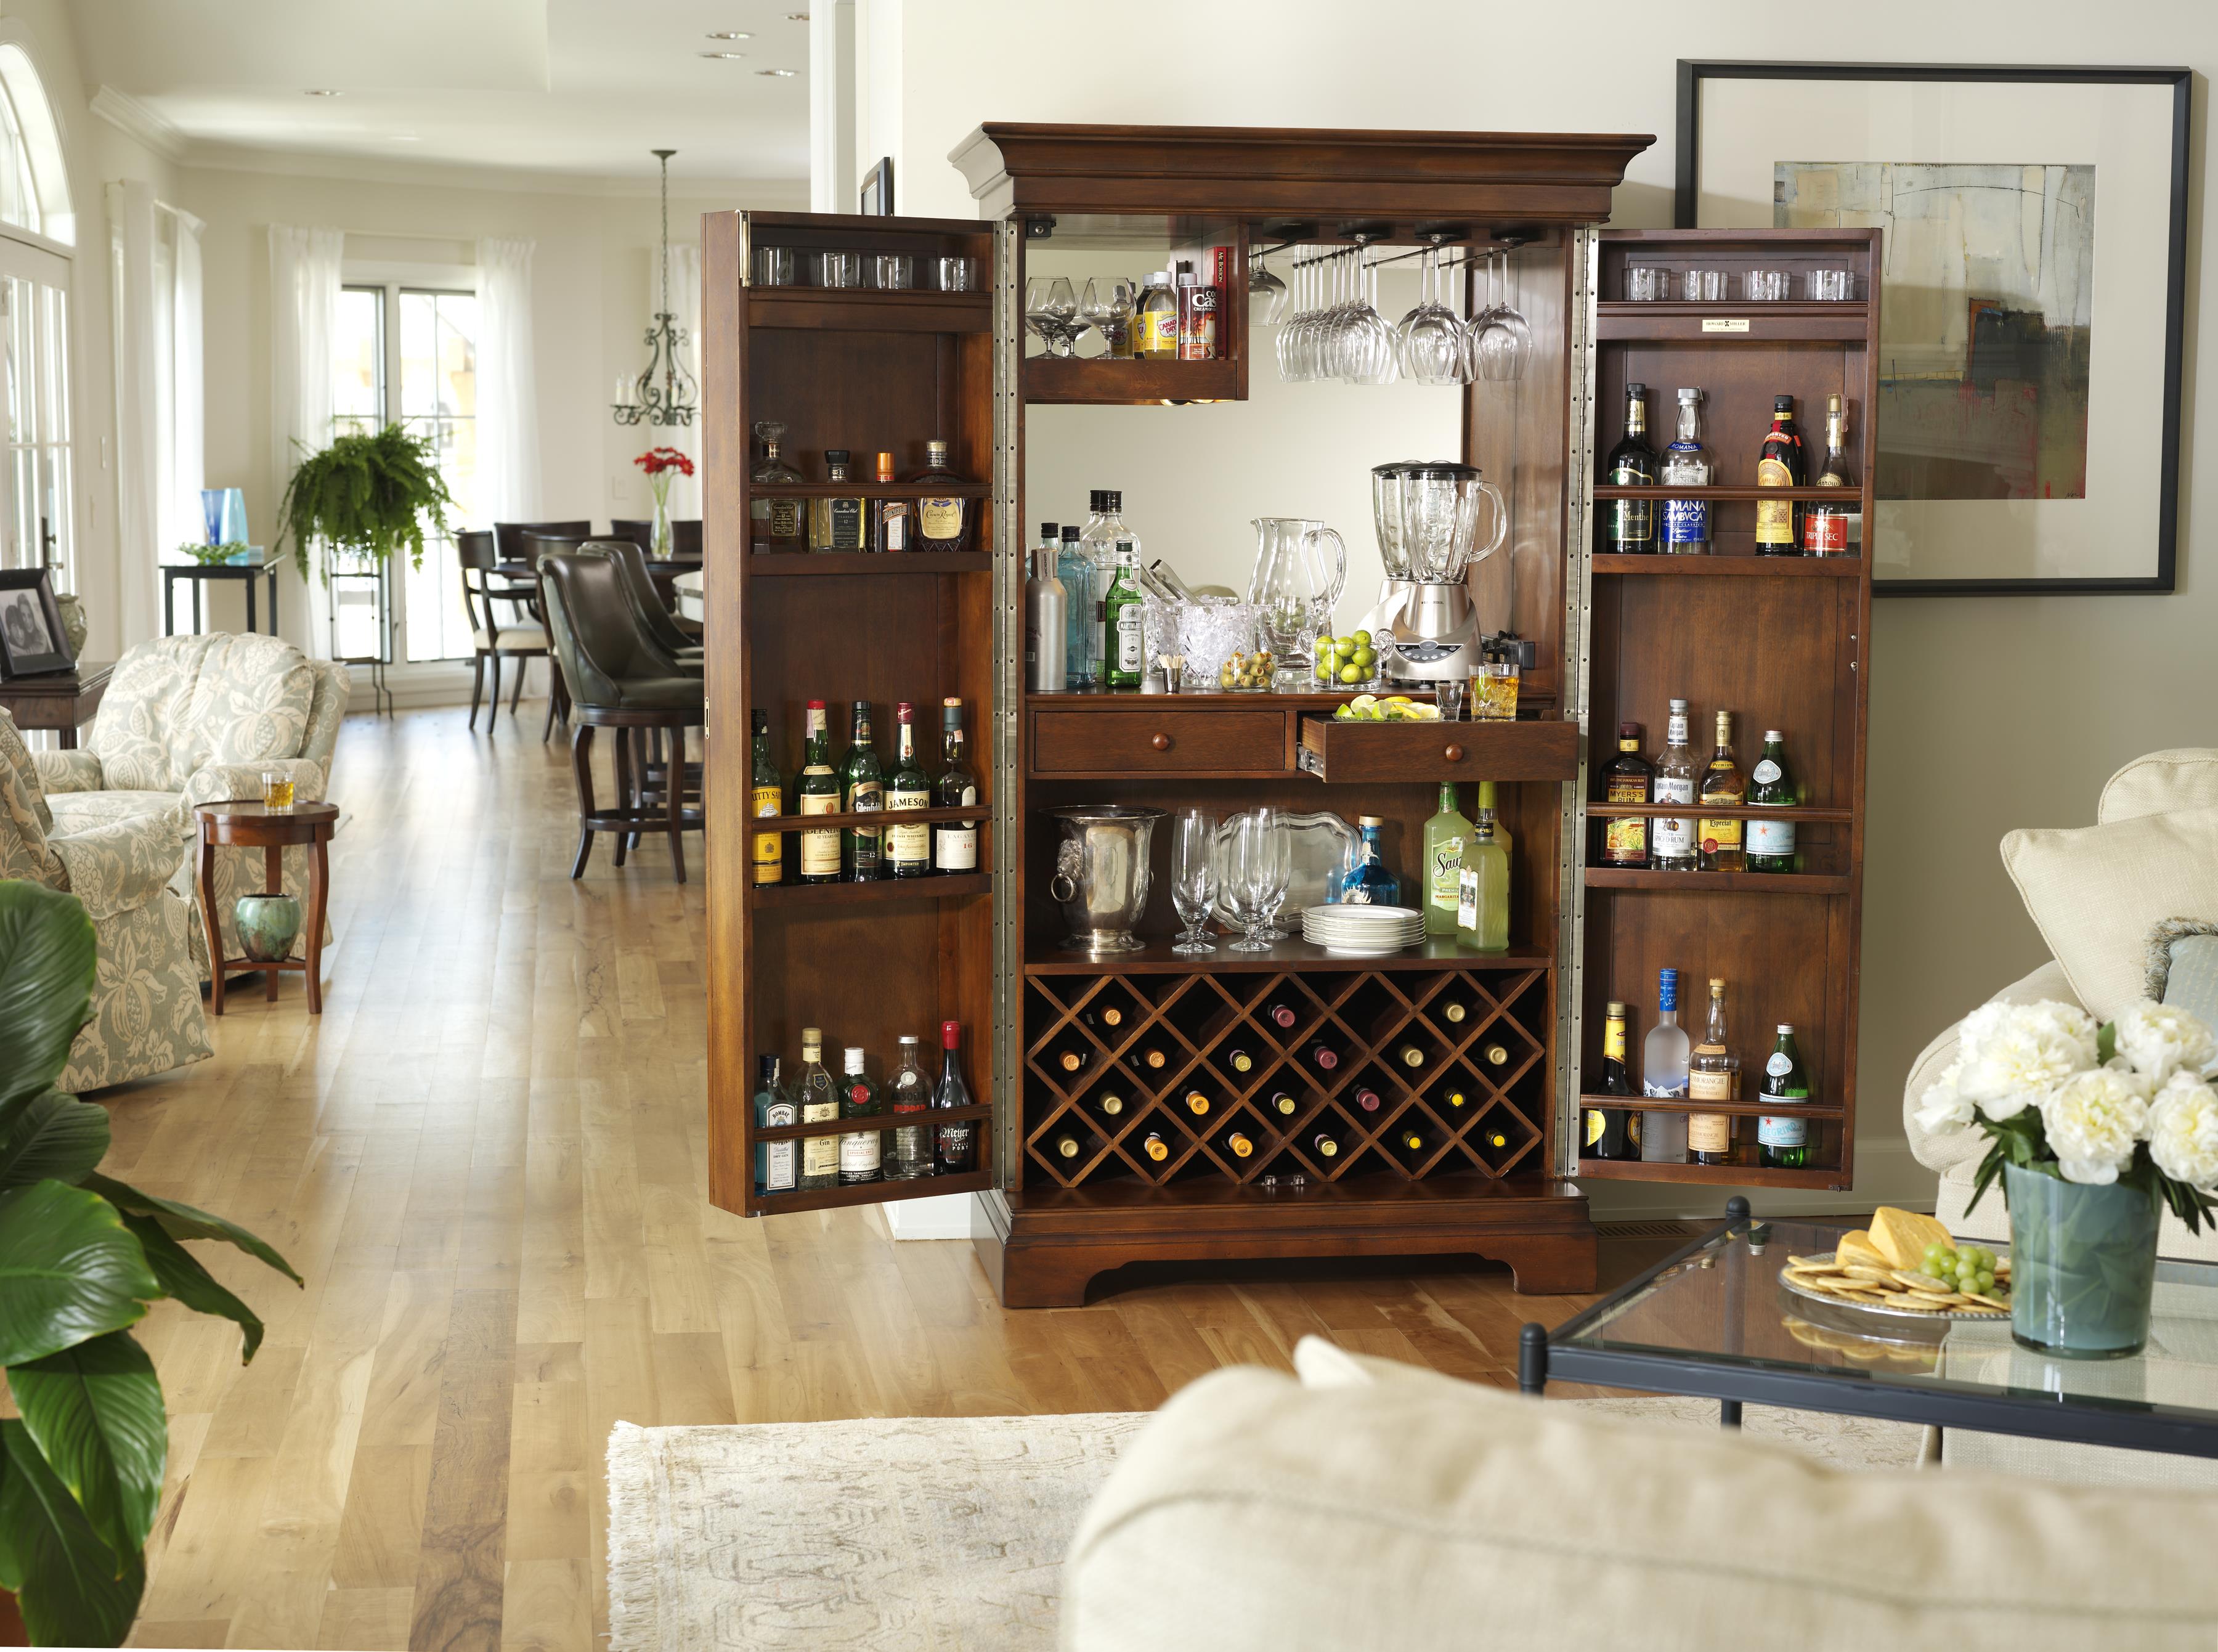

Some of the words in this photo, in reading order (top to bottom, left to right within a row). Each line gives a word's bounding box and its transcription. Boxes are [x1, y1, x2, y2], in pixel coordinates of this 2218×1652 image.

[1192, 294, 1217, 308] Cas
[1159, 319, 1177, 331] CANAD
[1165, 325, 1177, 334] DRY
[1662, 500, 1705, 511] ROMANA
[926, 510, 941, 519] Crown
[940, 510, 956, 519] Royal
[1623, 510, 1649, 521] Menthe
[1662, 511, 1704, 522] SAMBVCA
[1824, 532, 1838, 542] SEC
[1670, 721, 1684, 730] Captain
[1668, 782, 1689, 792] Morgan
[751, 791, 771, 802] UTTY
[888, 797, 928, 810] JAMESON
[1709, 819, 1733, 828] Especial
[1690, 1075, 1726, 1085] ENMORANGIE
[772, 1110, 790, 1120] BOMBAY
[940, 1128, 970, 1139] Meyer
[1759, 1122, 1797, 1137] ELLEGRINO
[839, 1136, 879, 1149] Tanqueray
